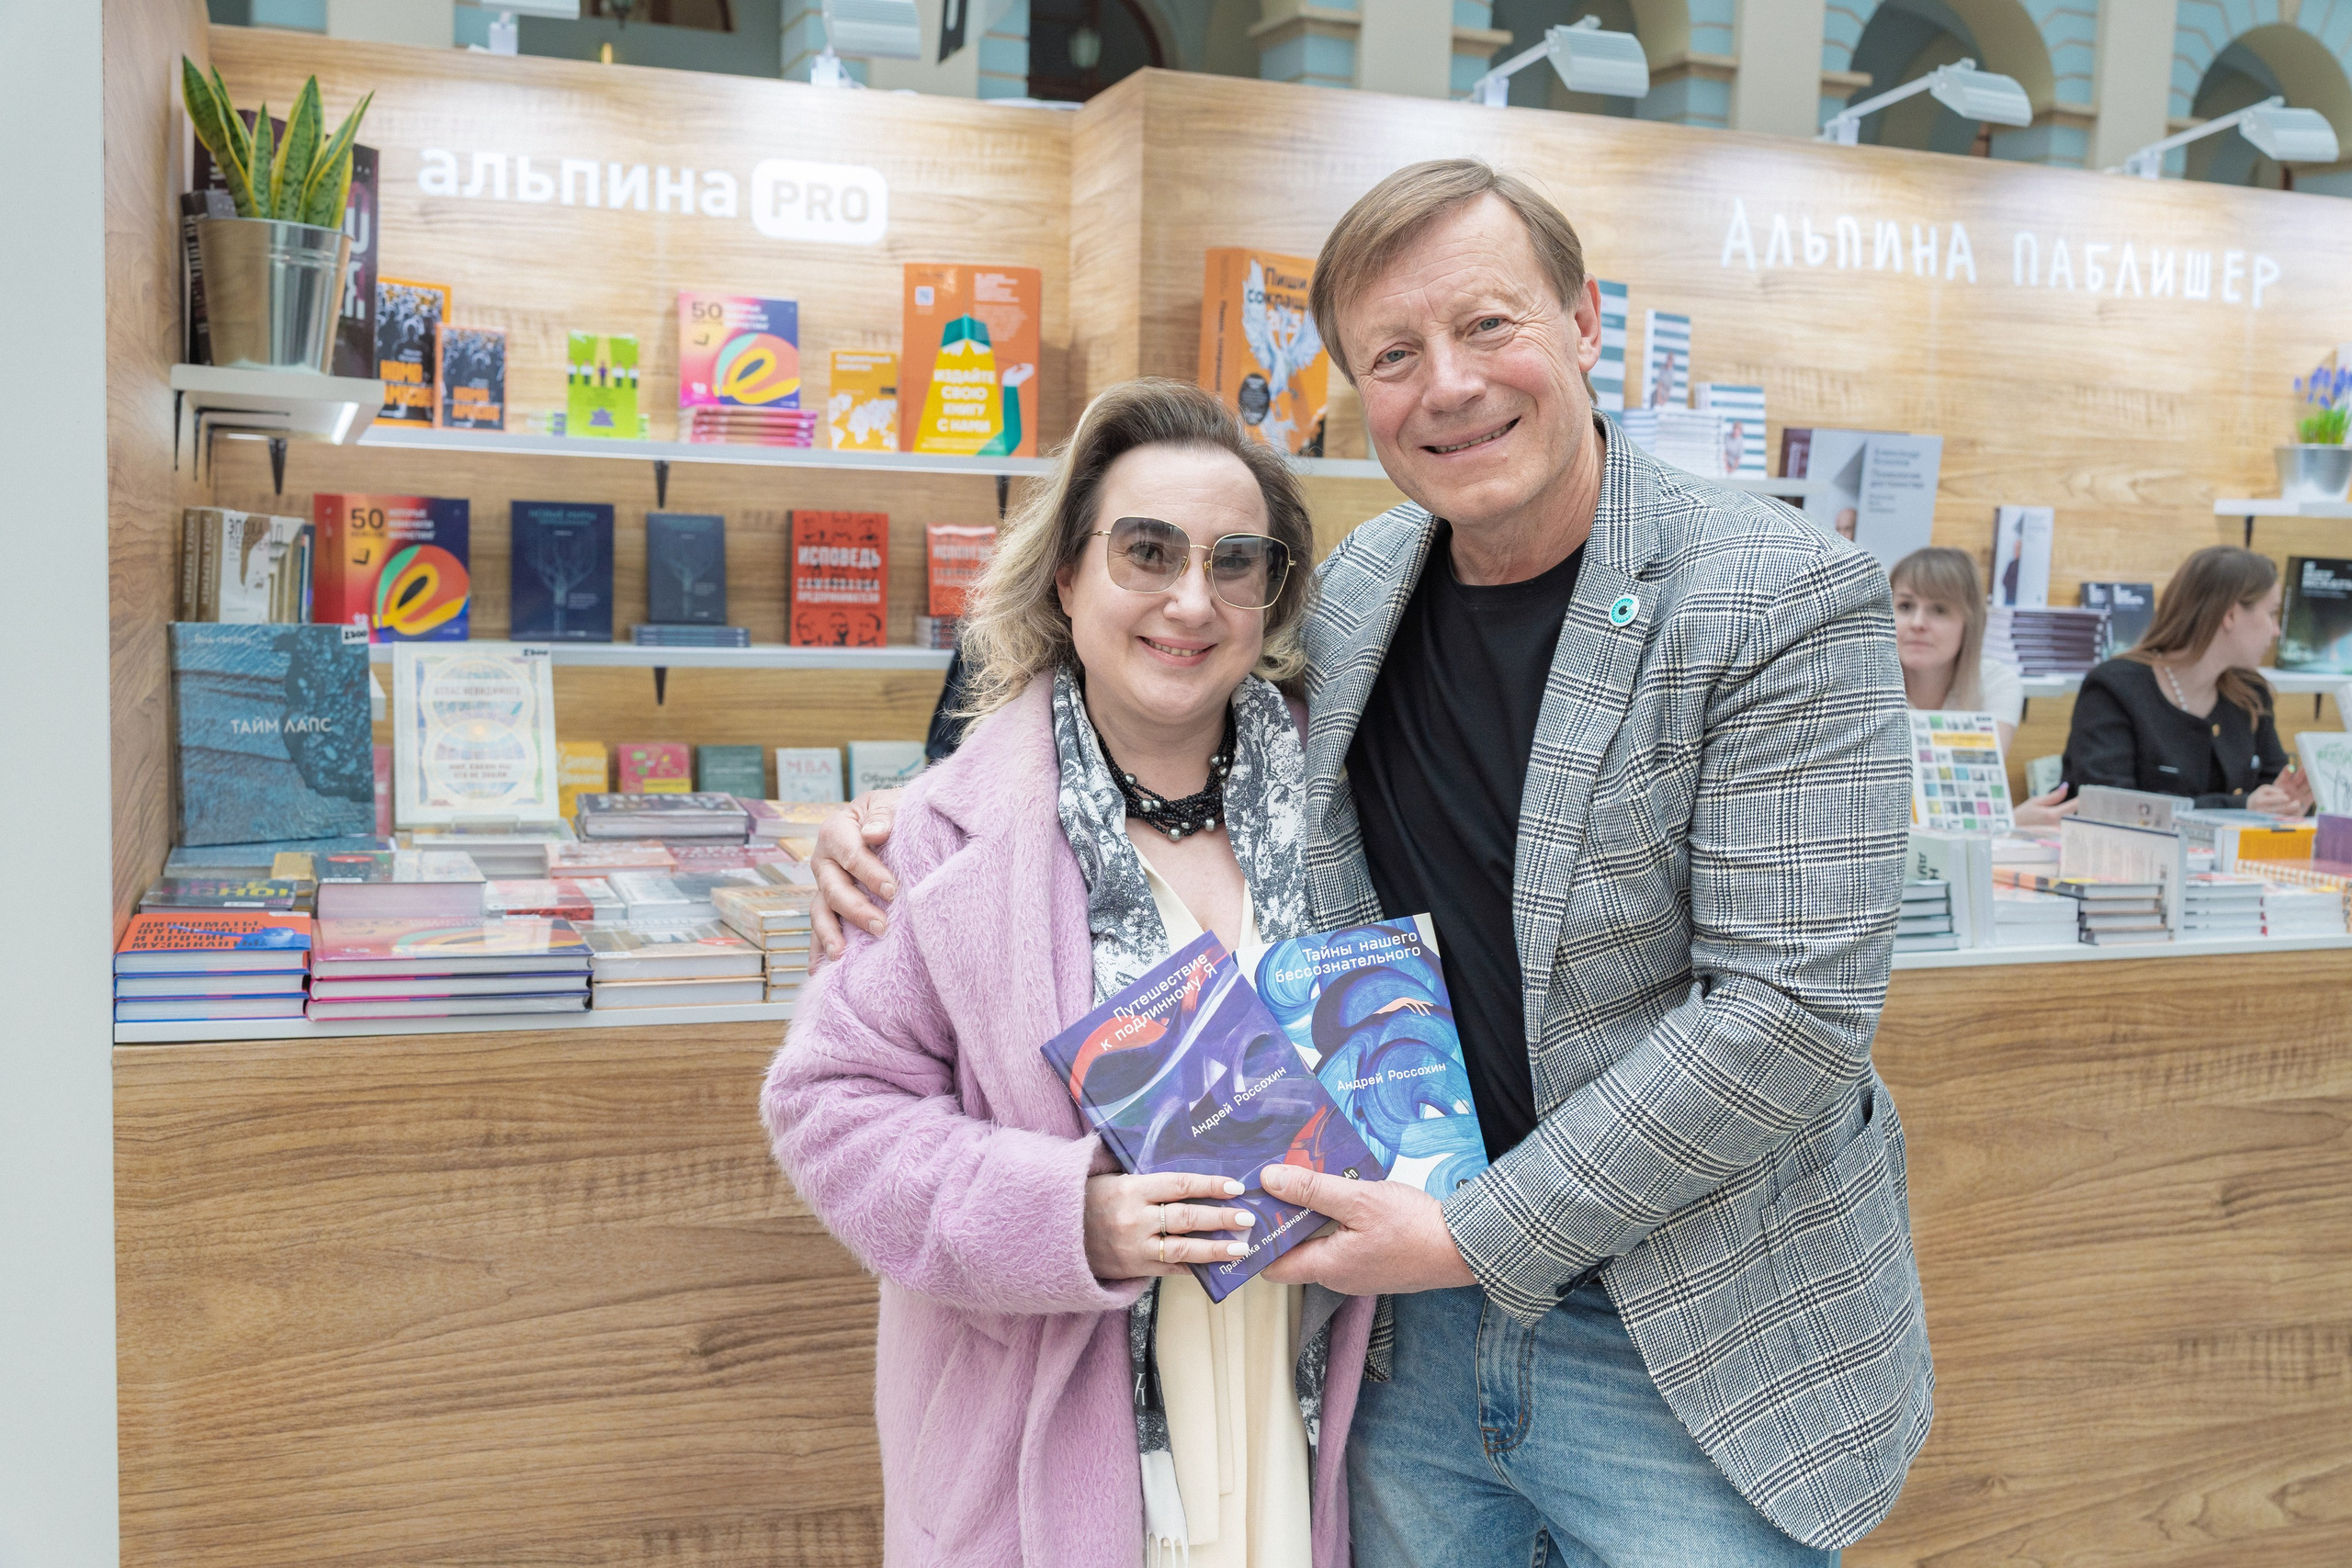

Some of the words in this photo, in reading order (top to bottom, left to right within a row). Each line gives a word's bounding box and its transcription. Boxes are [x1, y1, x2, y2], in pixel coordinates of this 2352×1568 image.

[417, 148, 739, 219] альпина
[771, 179, 870, 225] PRO
[692, 301, 723, 320] 50
[351, 508, 385, 530] 50
[797, 546, 881, 569] ИСПОВЕДЬ
[230, 716, 279, 734] ТАЙМ
[284, 717, 333, 733] ЛАПС
[1274, 943, 1421, 984] бессознательного
[1301, 943, 1353, 964] Тайны
[1358, 930, 1419, 955] нашего
[1099, 1038, 1113, 1052] к
[1114, 974, 1204, 1039] подлинному
[1202, 961, 1218, 979] Я
[1112, 951, 1210, 1022] Путешествие
[1336, 1072, 1385, 1092] Андрей
[1386, 1061, 1447, 1082] Россохин
[1190, 1102, 1235, 1139] Андрей
[1233, 1066, 1288, 1106] Россохин
[1261, 1207, 1315, 1247] психоанали
